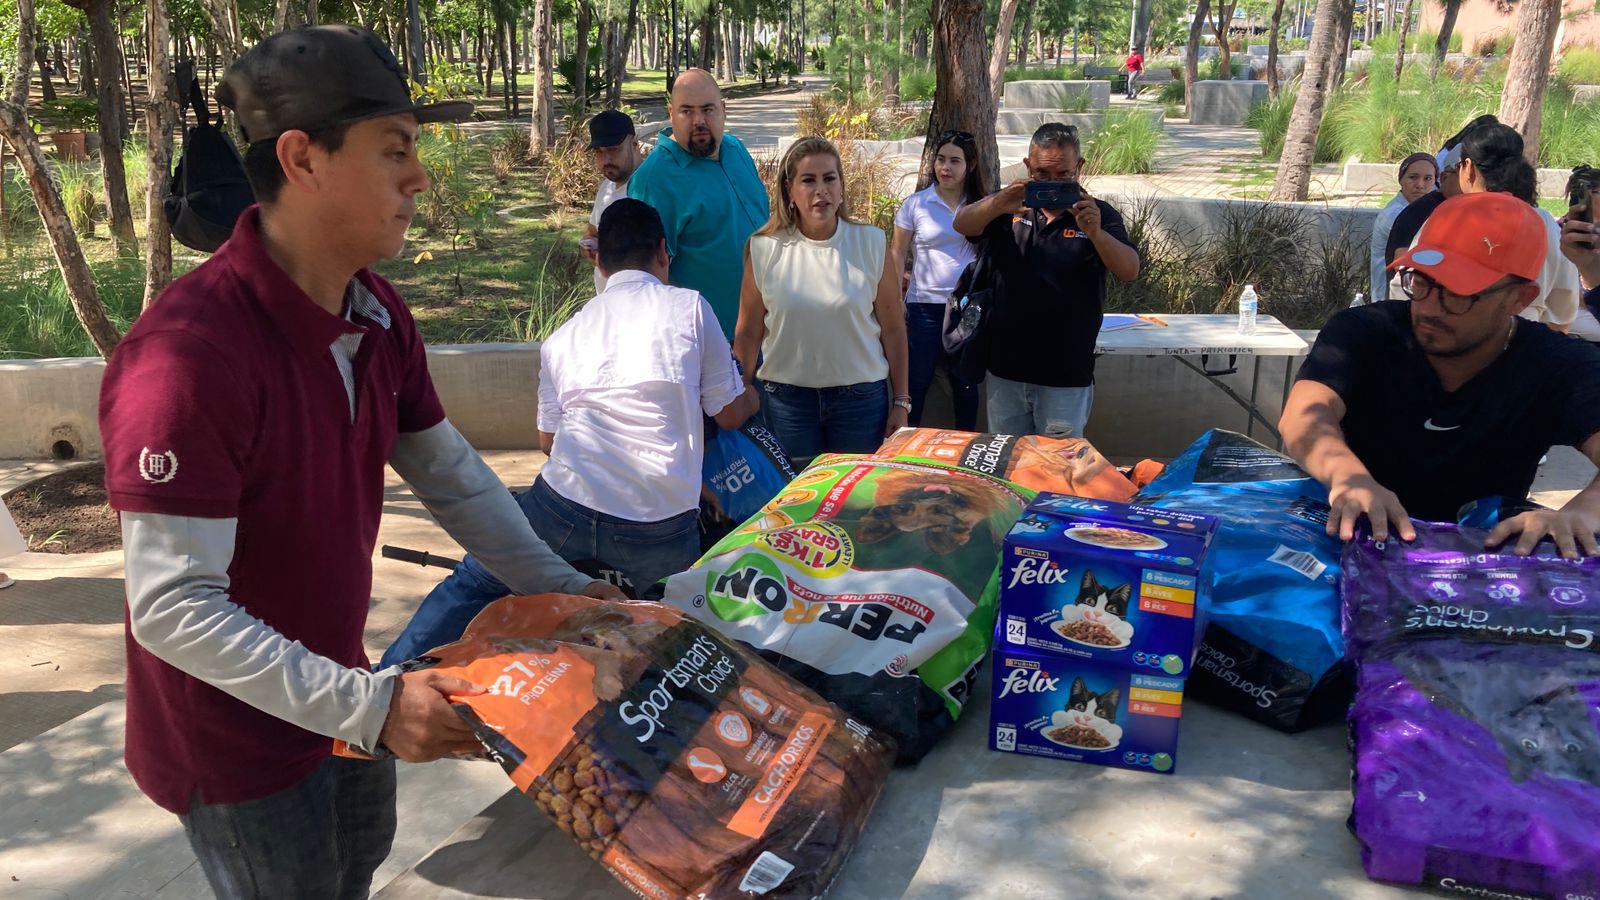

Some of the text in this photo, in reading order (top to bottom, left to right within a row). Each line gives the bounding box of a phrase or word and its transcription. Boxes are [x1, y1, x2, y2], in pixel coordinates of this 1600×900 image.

[715, 464, 756, 493] 20%
[1022, 549, 1047, 558] PURINA
[1007, 557, 1070, 590] felix
[1146, 572, 1190, 586] 8 PESCADO
[793, 582, 822, 600] nota
[841, 592, 865, 603] que
[713, 566, 927, 645] PERRON
[868, 593, 930, 619] Nutrición
[1144, 600, 1151, 608] 8
[1414, 604, 1489, 623] Choice
[1008, 623, 1025, 638] 24
[697, 655, 735, 693] Choice
[1012, 660, 1039, 669] PURINA
[519, 661, 573, 706] PROTEINA
[618, 635, 717, 743] Sportsman's
[998, 667, 1061, 699] felix
[1142, 680, 1178, 689] PESCADO
[998, 730, 1015, 745] 24
[753, 724, 815, 804] CACHORROS
